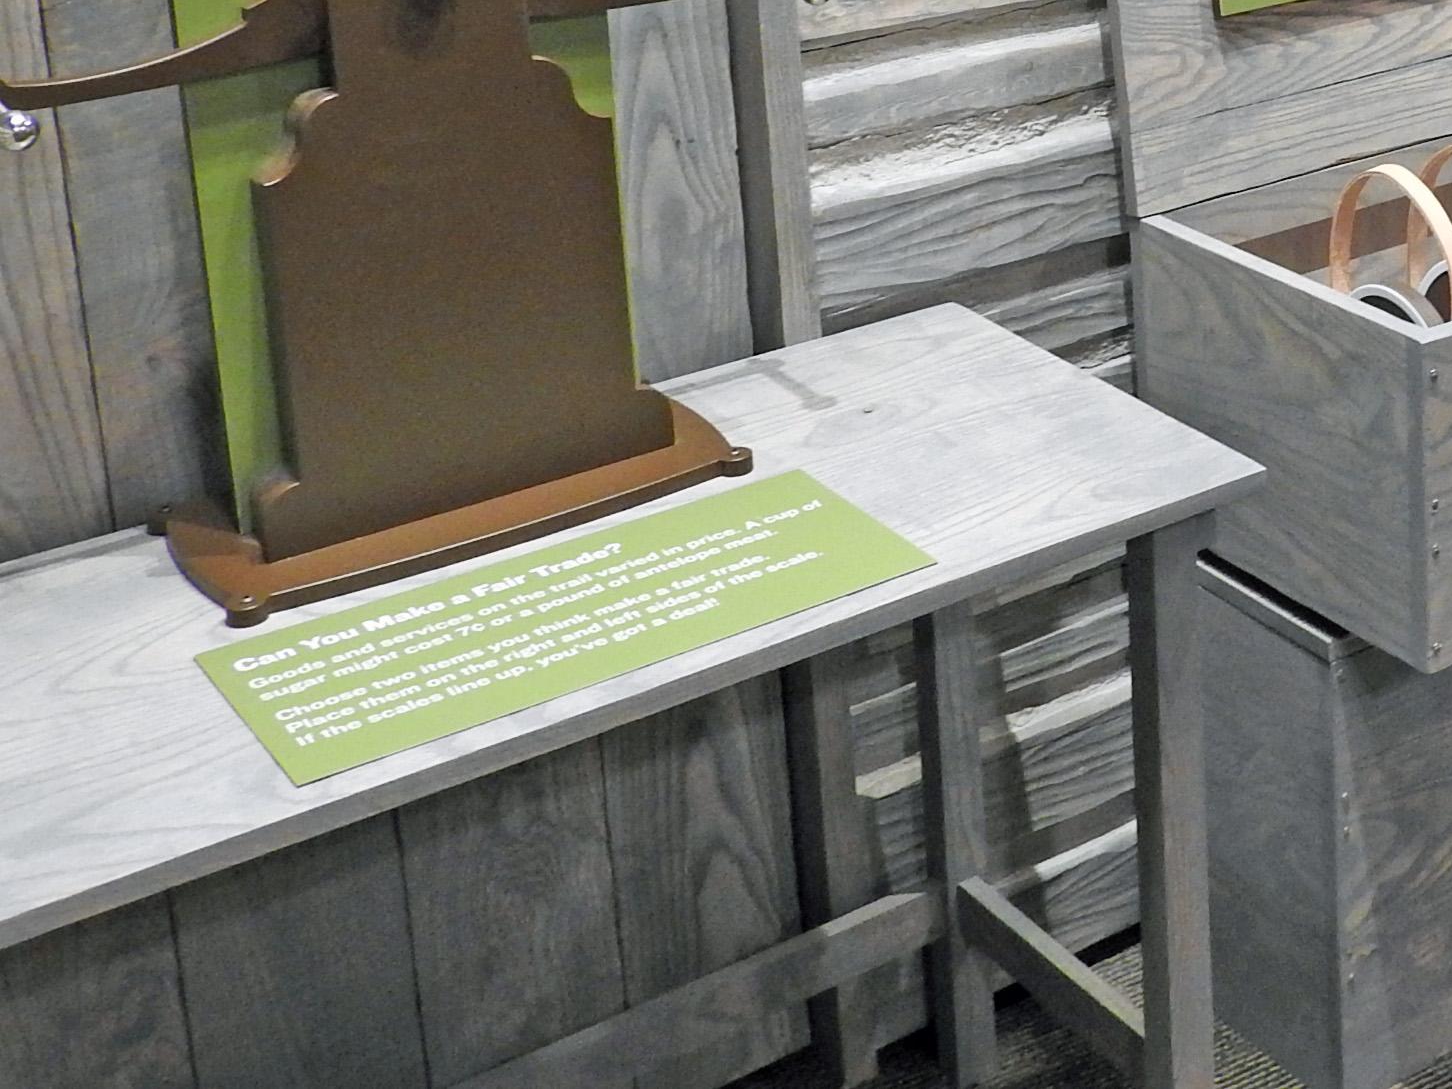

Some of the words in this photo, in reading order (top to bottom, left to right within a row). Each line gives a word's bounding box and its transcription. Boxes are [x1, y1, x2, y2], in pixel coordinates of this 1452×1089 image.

[232, 647, 297, 672] Can
[298, 627, 360, 650] You
[361, 601, 446, 632] Make
[449, 594, 471, 605] a
[470, 574, 526, 597] Fair
[528, 542, 621, 577] Trade?
[248, 660, 326, 689] Goods
[331, 643, 376, 663] and
[380, 614, 474, 647] services
[478, 603, 507, 616] on
[509, 590, 546, 605] the
[549, 573, 592, 592] trail
[595, 551, 660, 577] varied
[662, 546, 684, 556] in
[685, 529, 741, 550] price.
[745, 520, 762, 530] A
[762, 508, 800, 524] cup
[801, 499, 822, 511] of
[259, 674, 326, 701] sugar
[332, 651, 398, 677] might
[403, 633, 453, 654] cost
[489, 614, 512, 626] or
[519, 608, 534, 617] a
[536, 583, 605, 613] pound
[607, 574, 630, 587] of
[634, 547, 721, 579] antelope
[723, 529, 778, 549] meat.
[274, 687, 368, 721] Choose
[371, 671, 416, 689] two
[420, 649, 485, 674] items
[487, 633, 530, 653] you
[532, 614, 590, 636] think
[593, 593, 651, 616] make
[655, 587, 670, 595] a
[671, 574, 706, 590] fair
[710, 555, 770, 576] trade.
[284, 707, 355, 734] Place
[358, 685, 421, 709] them
[426, 673, 457, 687] on
[459, 659, 499, 675] the
[503, 639, 556, 661] right
[560, 622, 603, 642] and
[603, 610, 641, 627] left
[645, 591, 701, 613] sides
[703, 580, 725, 593] of
[727, 570, 763, 585] the
[764, 551, 824, 573] scale.
[294, 732, 316, 747] If
[319, 720, 362, 738] the
[367, 693, 444, 723] scales
[445, 677, 491, 696] line
[495, 665, 534, 680] up,
[535, 637, 608, 668] you've
[611, 623, 647, 642] got
[651, 618, 668, 627] a
[668, 597, 720, 620] deal!
